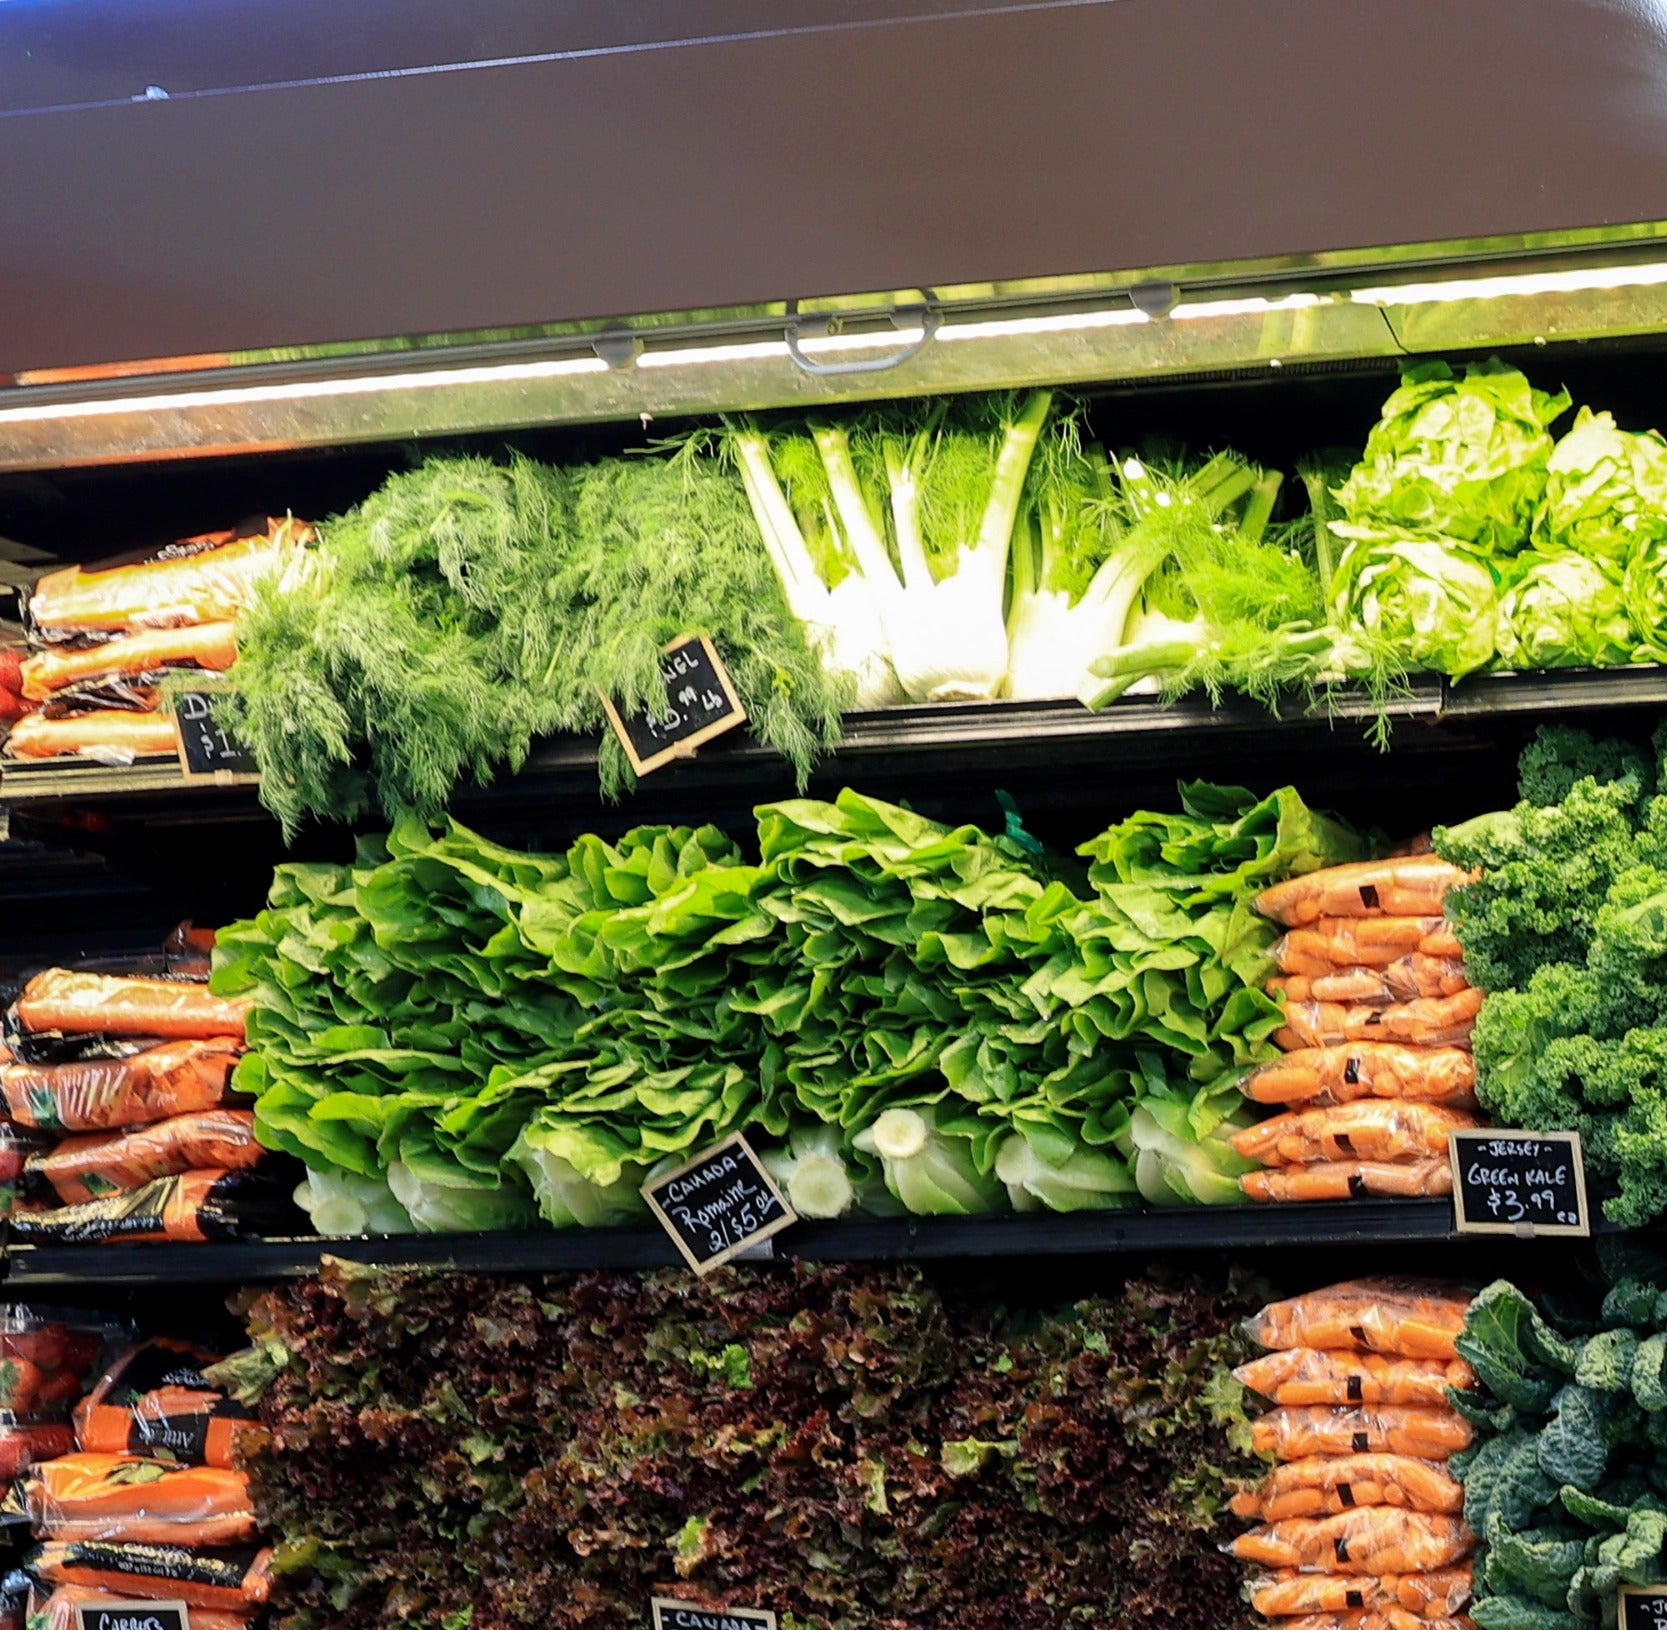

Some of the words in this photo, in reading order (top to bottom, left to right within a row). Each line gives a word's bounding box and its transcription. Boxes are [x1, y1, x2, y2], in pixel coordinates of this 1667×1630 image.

[1467, 1162, 1520, 1186] GREEN
[1525, 1164, 1567, 1187] KALE
[671, 1178, 758, 1234] Romaine
[1486, 1186, 1555, 1221] $3.99
[1556, 1210, 1578, 1225] ea
